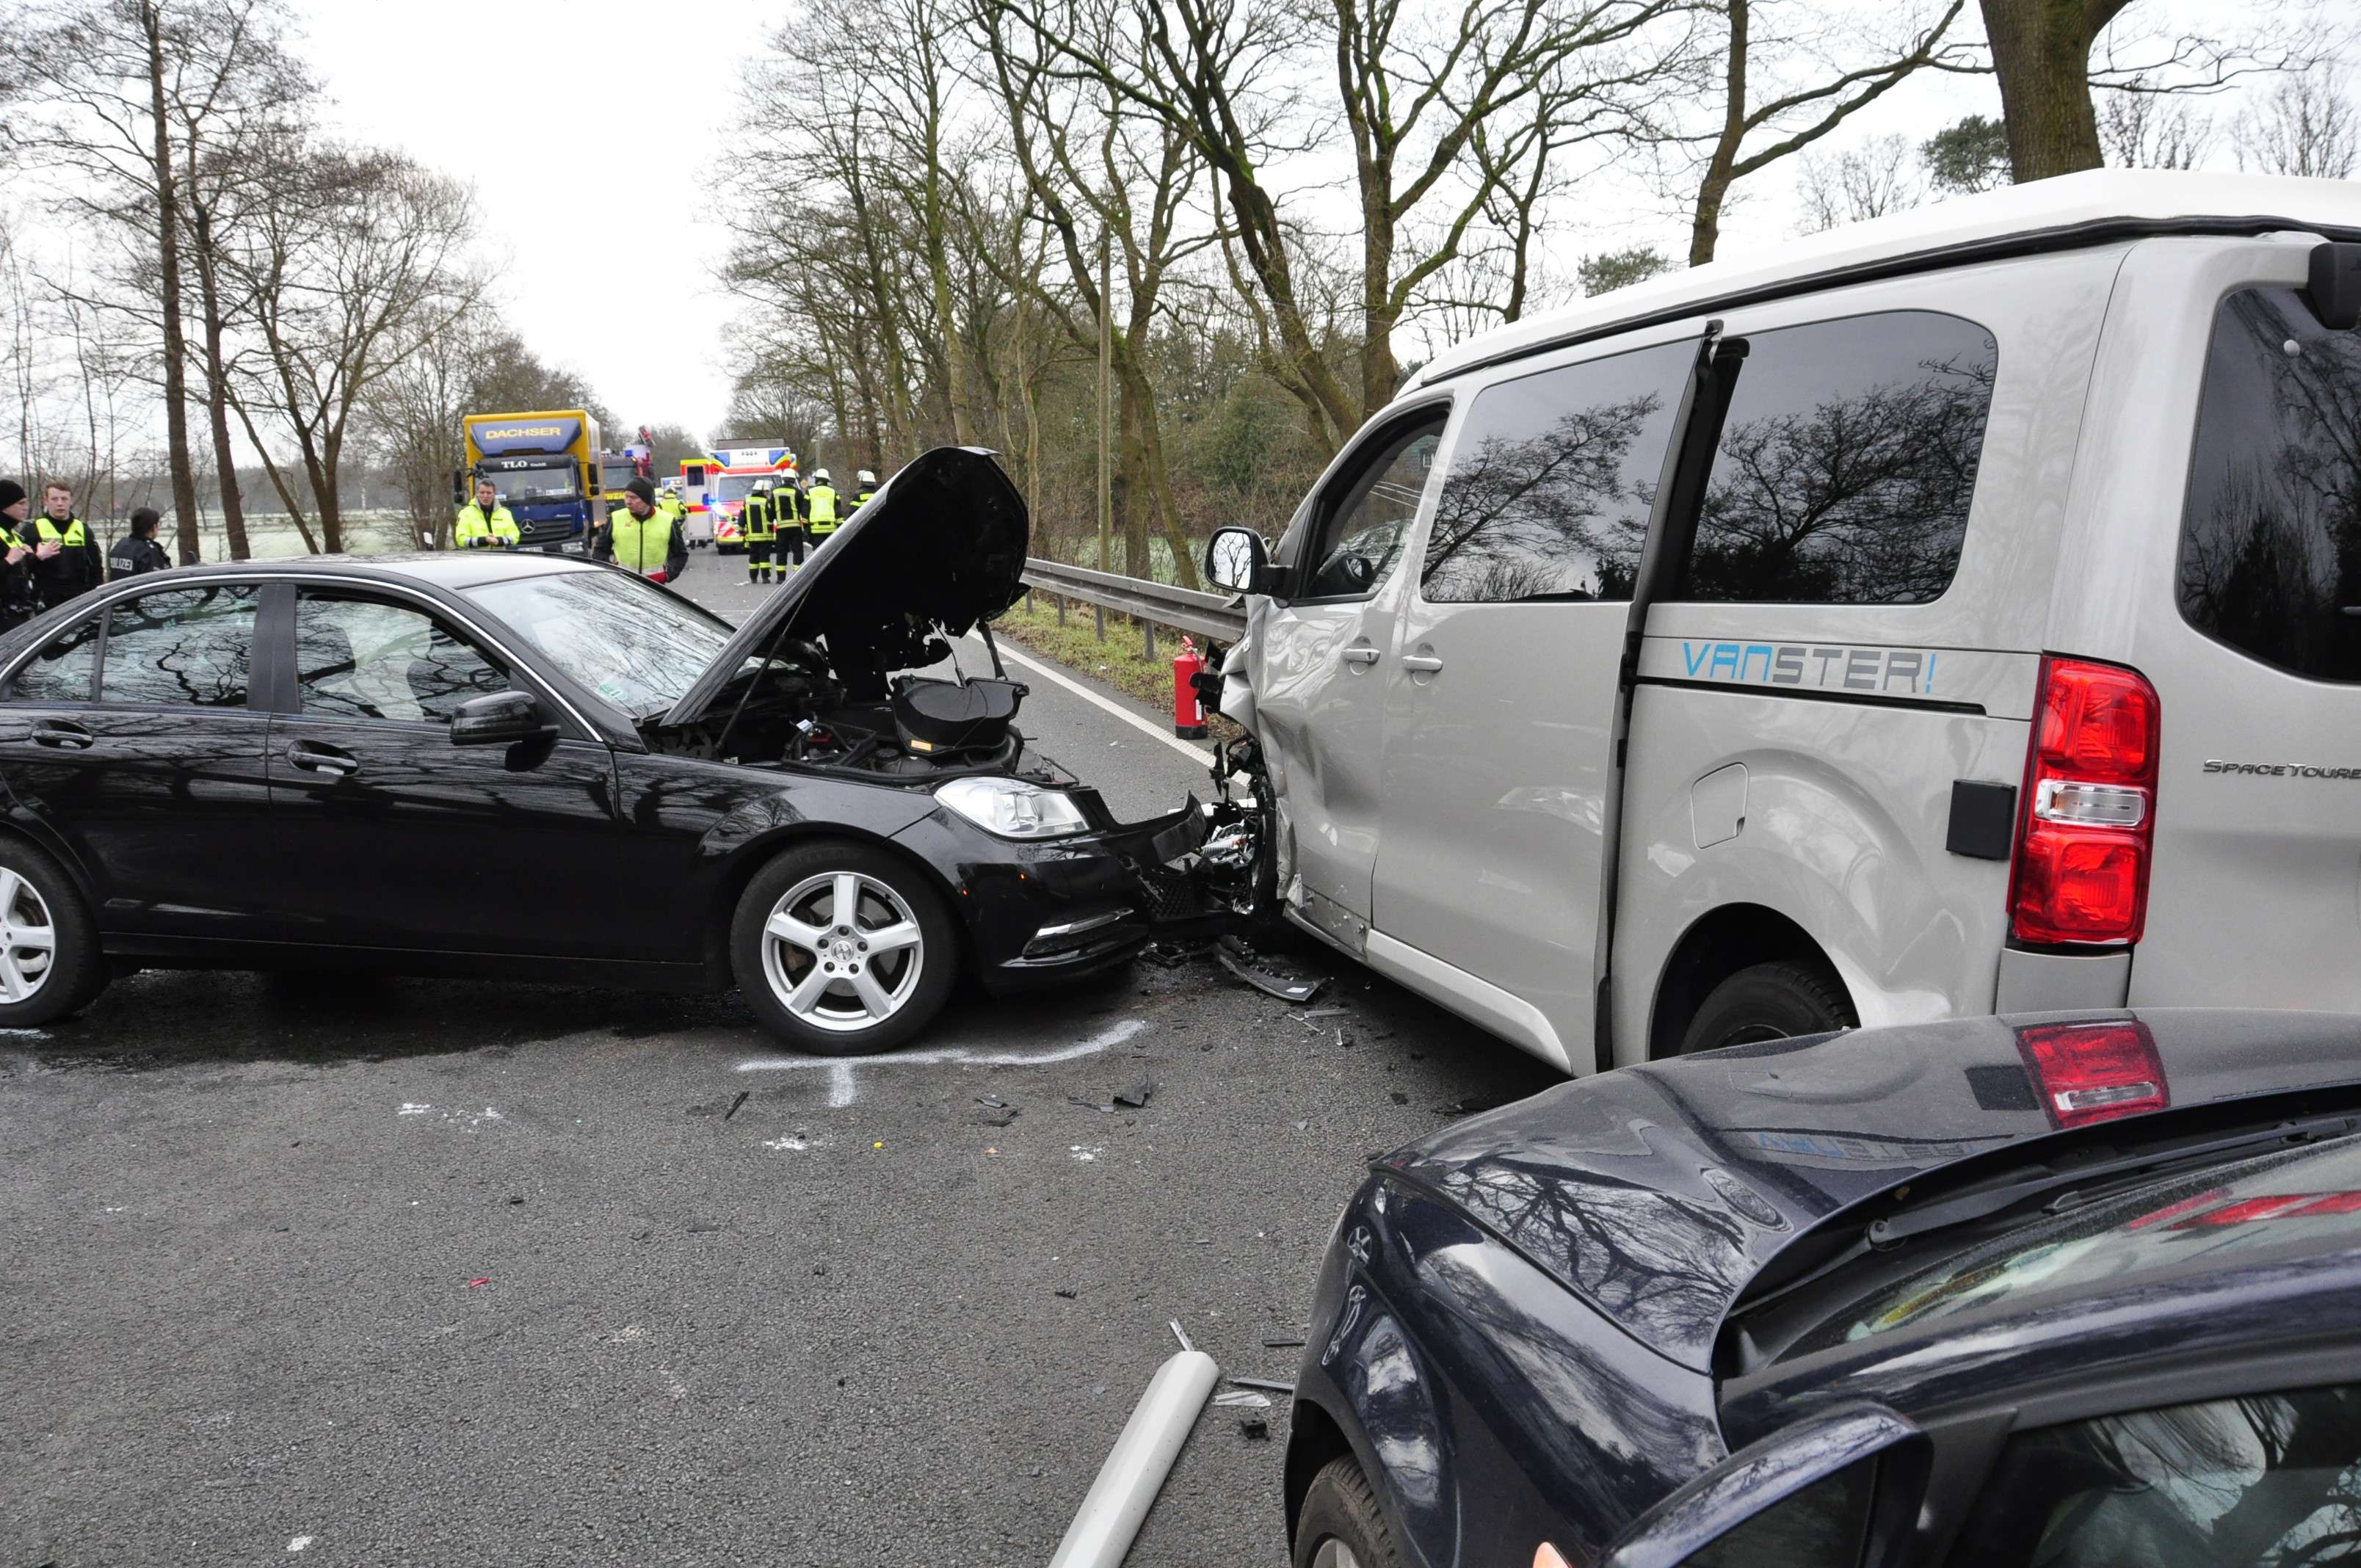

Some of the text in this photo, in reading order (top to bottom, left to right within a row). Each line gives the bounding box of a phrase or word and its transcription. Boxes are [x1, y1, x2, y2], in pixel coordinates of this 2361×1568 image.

[485, 427, 561, 439] DACHSER
[501, 460, 527, 468] TLO
[1683, 642, 1937, 694] VANSTER!
